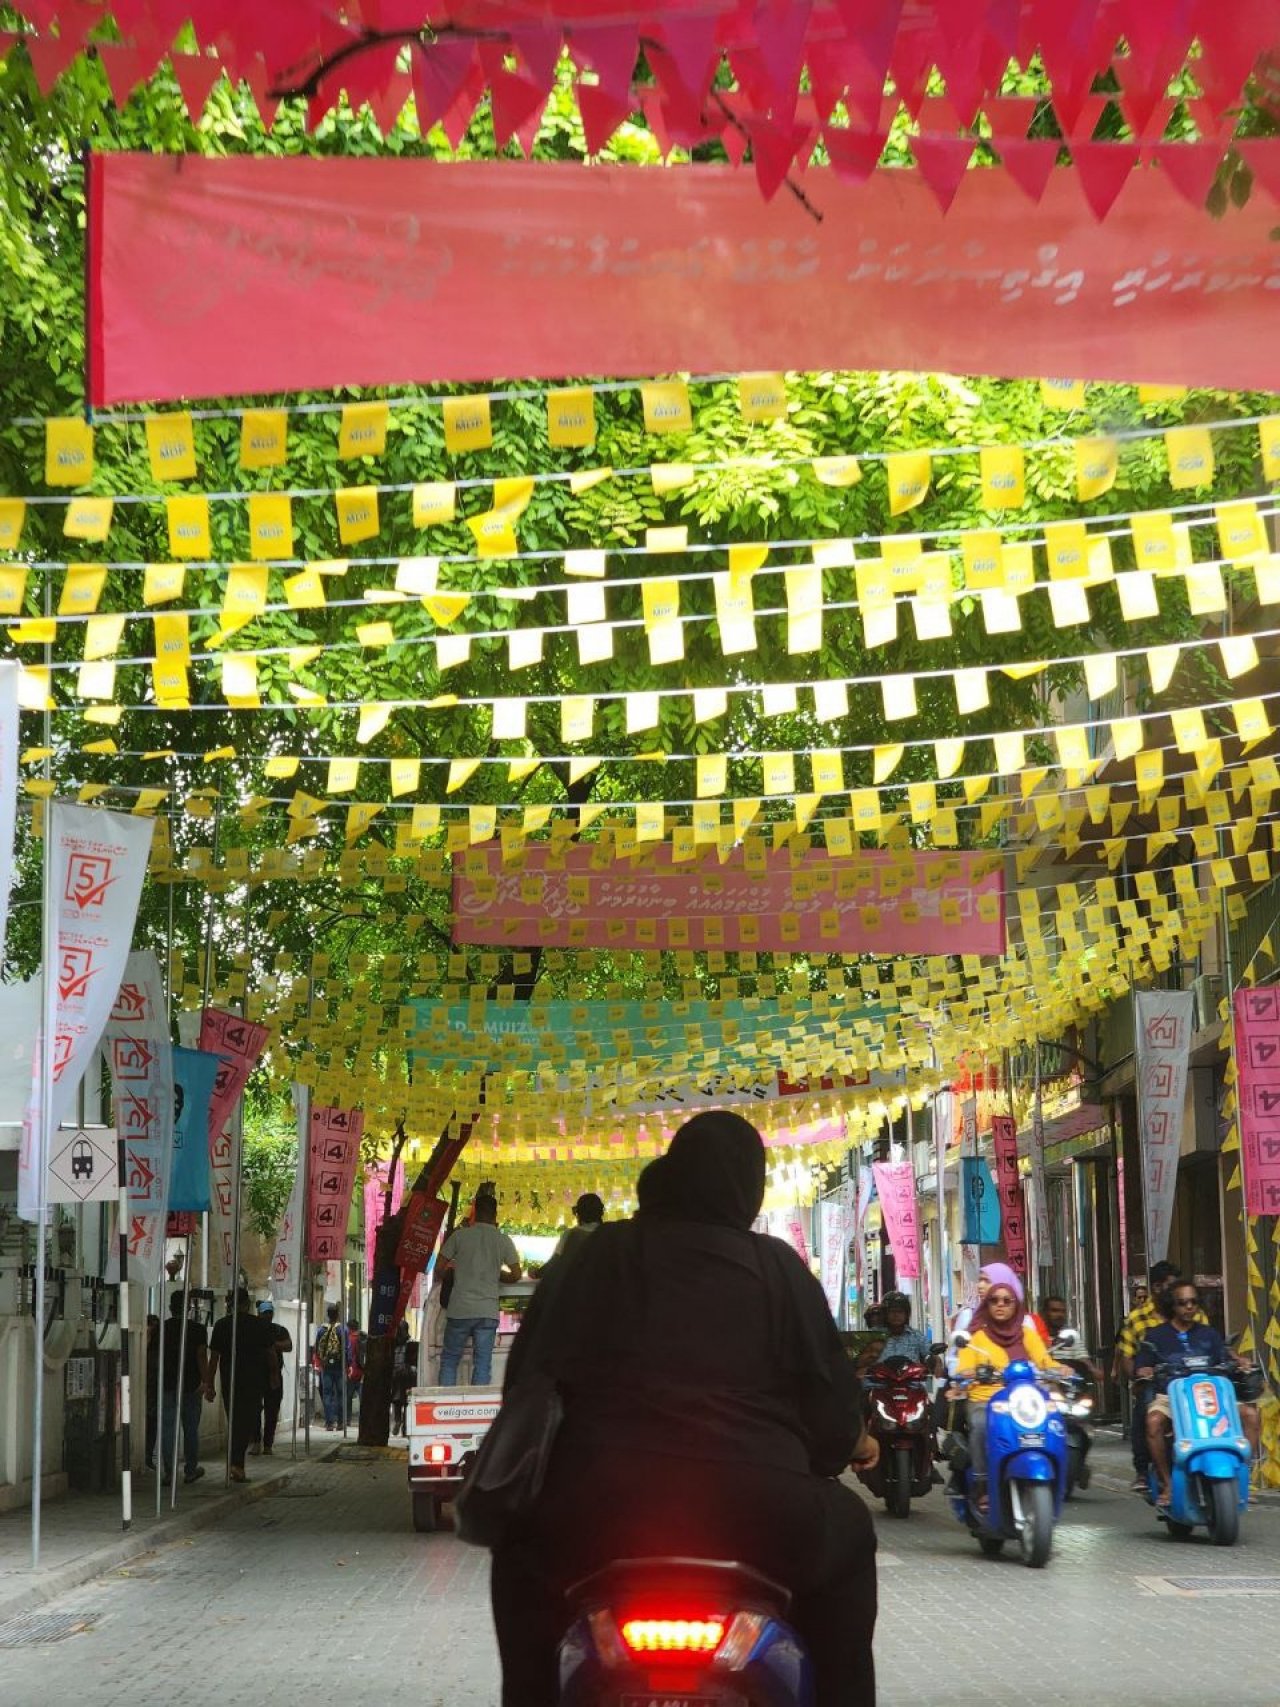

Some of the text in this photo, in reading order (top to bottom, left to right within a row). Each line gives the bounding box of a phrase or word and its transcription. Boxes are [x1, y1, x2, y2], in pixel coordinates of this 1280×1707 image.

[75, 863, 97, 890] 5
[60, 955, 77, 981] 5
[1250, 995, 1272, 1015] 4
[227, 1027, 246, 1047] 4
[1255, 1042, 1276, 1060] 4
[331, 1113, 347, 1127] 4
[327, 1145, 342, 1159] 4
[323, 1177, 338, 1191] 4
[319, 1209, 332, 1222] 4
[318, 1241, 328, 1254] 4
[438, 1408, 500, 1418] veligaa.com
